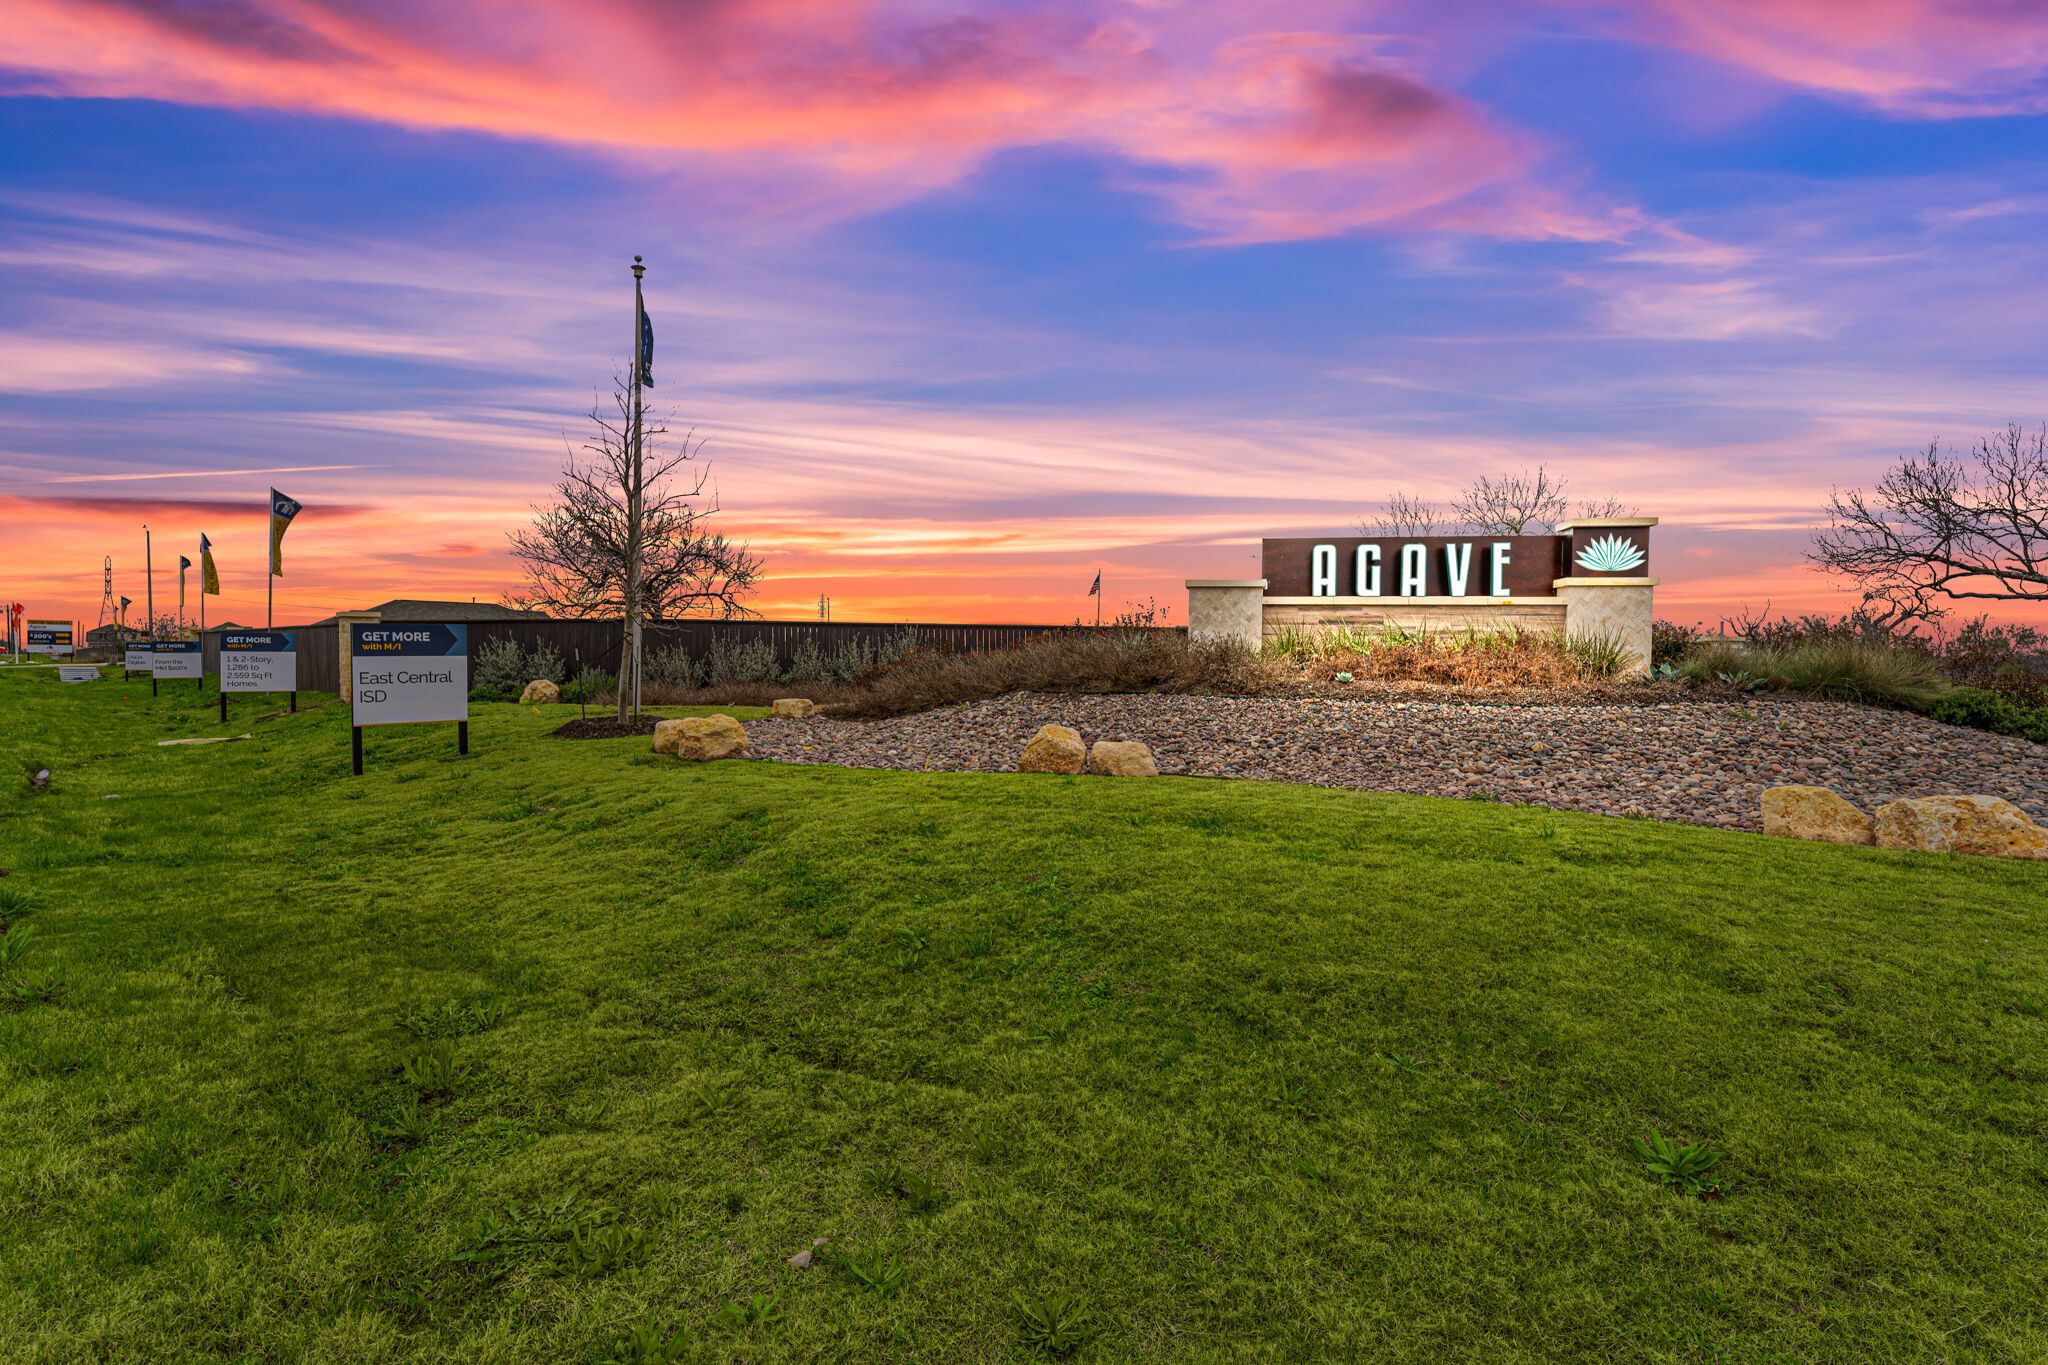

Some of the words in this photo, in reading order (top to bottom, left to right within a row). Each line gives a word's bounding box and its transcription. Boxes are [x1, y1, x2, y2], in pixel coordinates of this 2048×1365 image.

[1312, 541, 1511, 597] AGAVE
[362, 632, 389, 641] GET
[392, 632, 430, 642] MORE
[251, 672, 262, 680] Sq
[359, 671, 394, 685] East
[397, 670, 453, 684] Central
[360, 690, 387, 703] ISD
